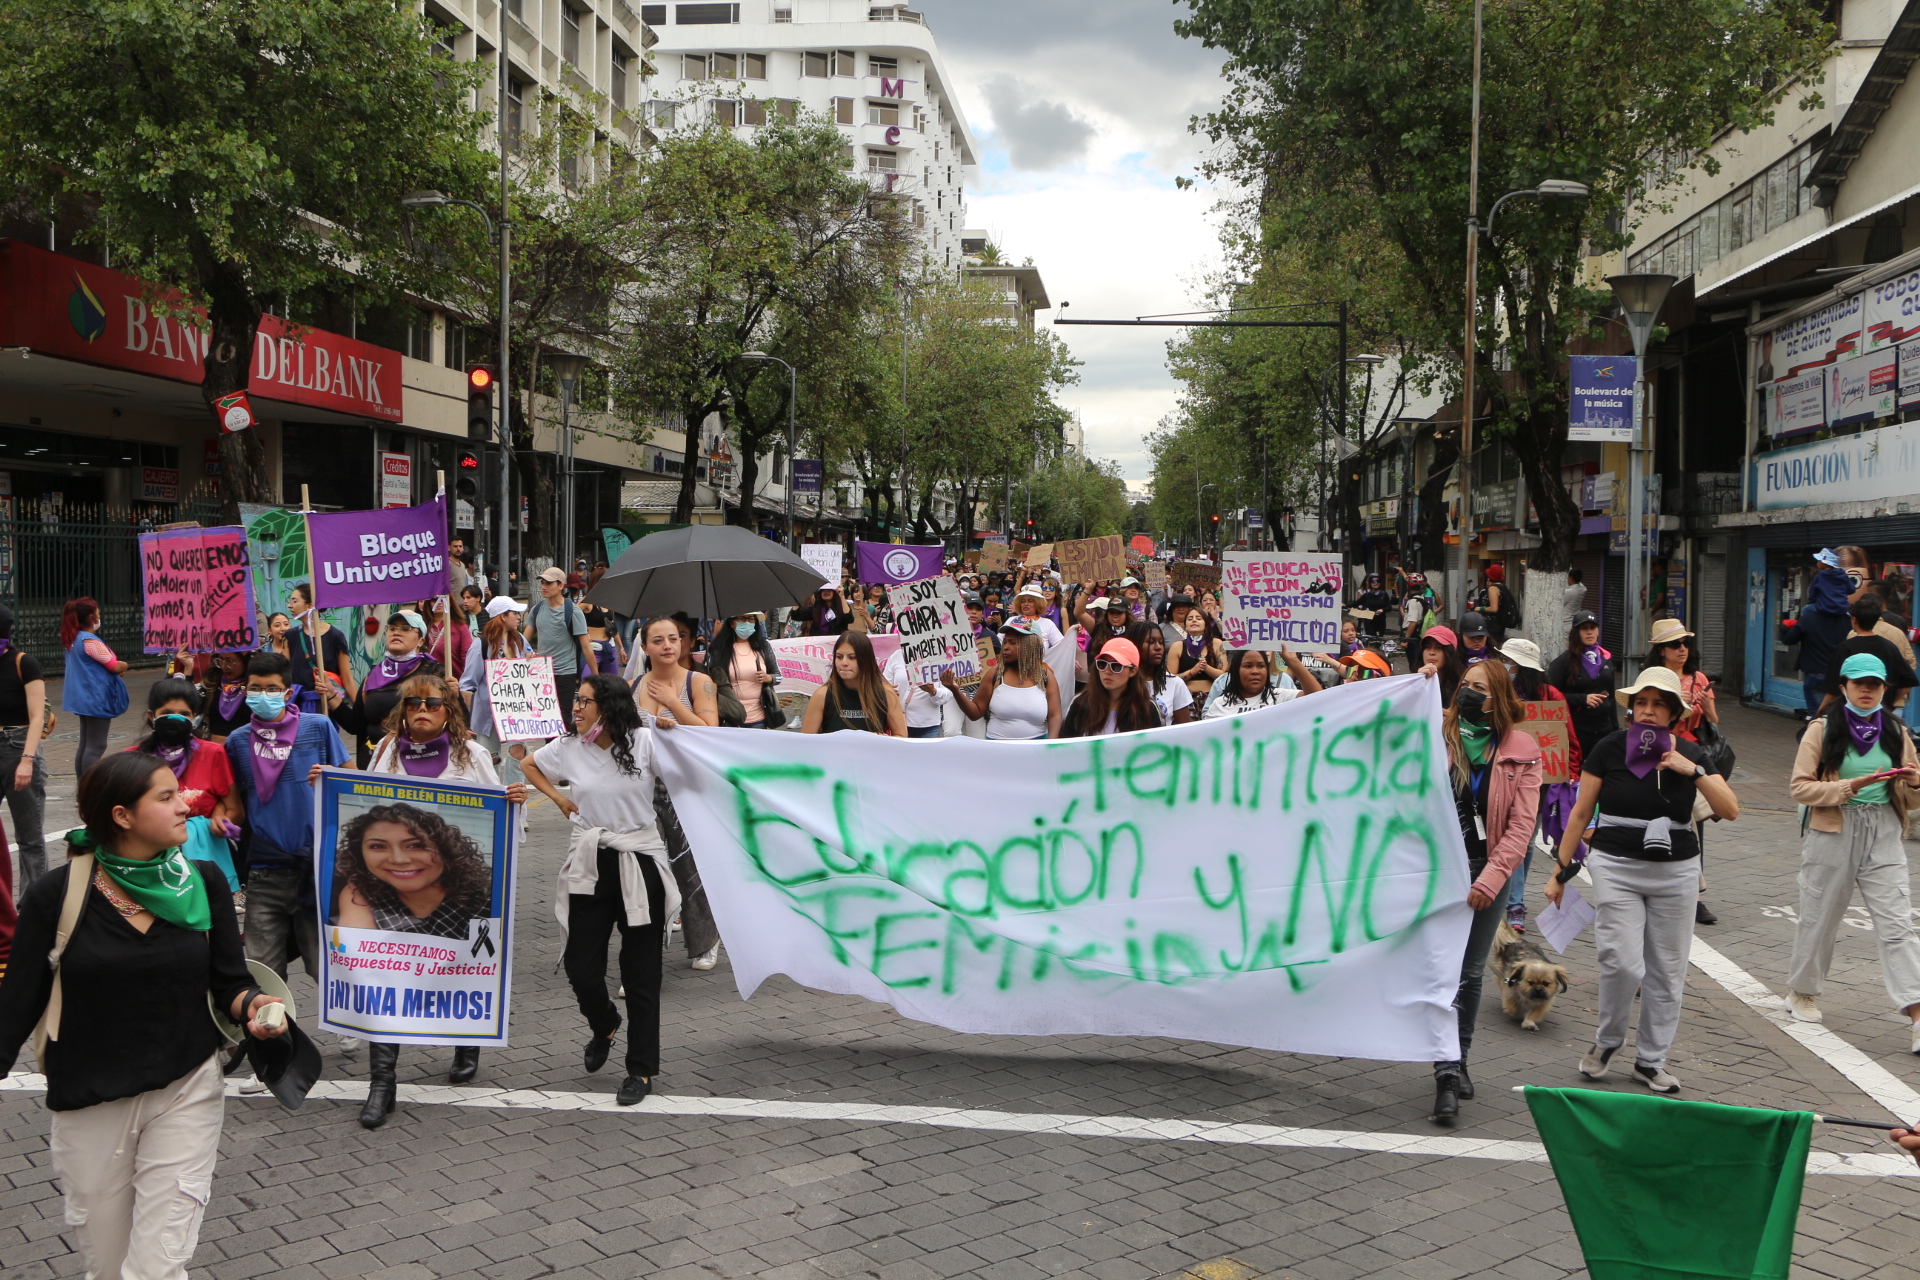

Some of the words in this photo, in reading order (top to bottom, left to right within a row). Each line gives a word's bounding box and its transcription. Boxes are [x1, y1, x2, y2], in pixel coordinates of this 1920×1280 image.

[1775, 325, 1794, 344] POR
[1796, 318, 1808, 336] LA
[1810, 296, 1860, 330] DIGNIDAD
[1786, 340, 1799, 357] DE
[1802, 327, 1832, 351] QUITO
[256, 331, 382, 405] DELBANK
[1574, 387, 1619, 396] Boulevard
[1620, 388, 1634, 396] de
[1782, 382, 1803, 395] Cuidemos
[1805, 379, 1810, 389] la
[1810, 375, 1821, 387] Vida
[1584, 399, 1592, 407] la
[1594, 399, 1623, 408] música
[144, 469, 177, 484] CAJERO
[386, 460, 408, 474] Créditos
[1766, 444, 1850, 492] FUNDACIÓN
[359, 530, 436, 557] Bloque
[803, 546, 816, 557] Por
[818, 546, 829, 557] las
[830, 550, 841, 561] que
[1063, 537, 1121, 561] ESTADO
[147, 550, 163, 571] NO
[1061, 558, 1121, 584] FEMICIDA
[908, 579, 939, 604] SOY
[1238, 595, 1334, 610] FEMINISMO
[149, 598, 184, 620] vamos
[187, 600, 194, 620] a
[896, 605, 942, 636] CHAPA
[943, 600, 958, 625] Y
[1266, 608, 1292, 619] NO
[900, 634, 948, 665] TAMBIÉN
[951, 632, 974, 654] SOY
[511, 663, 531, 679] SOY
[491, 681, 526, 698] CHAPA
[532, 682, 541, 697] Y
[492, 698, 533, 714] TAMBIÉN
[537, 697, 557, 712] SOY
[353, 783, 394, 798] MARÍA
[396, 788, 434, 802] BELÉN
[436, 792, 485, 808] BERNAL
[1193, 854, 1249, 972] y
[1283, 814, 1440, 954] NO
[357, 940, 457, 962] NECESITAMOS
[330, 950, 411, 972] ¡Respuestas
[414, 963, 426, 976] y
[428, 962, 498, 976] Justicia!
[329, 979, 350, 1010] ¡NI
[353, 984, 396, 1016] UNA
[402, 988, 493, 1020] MENOS!
